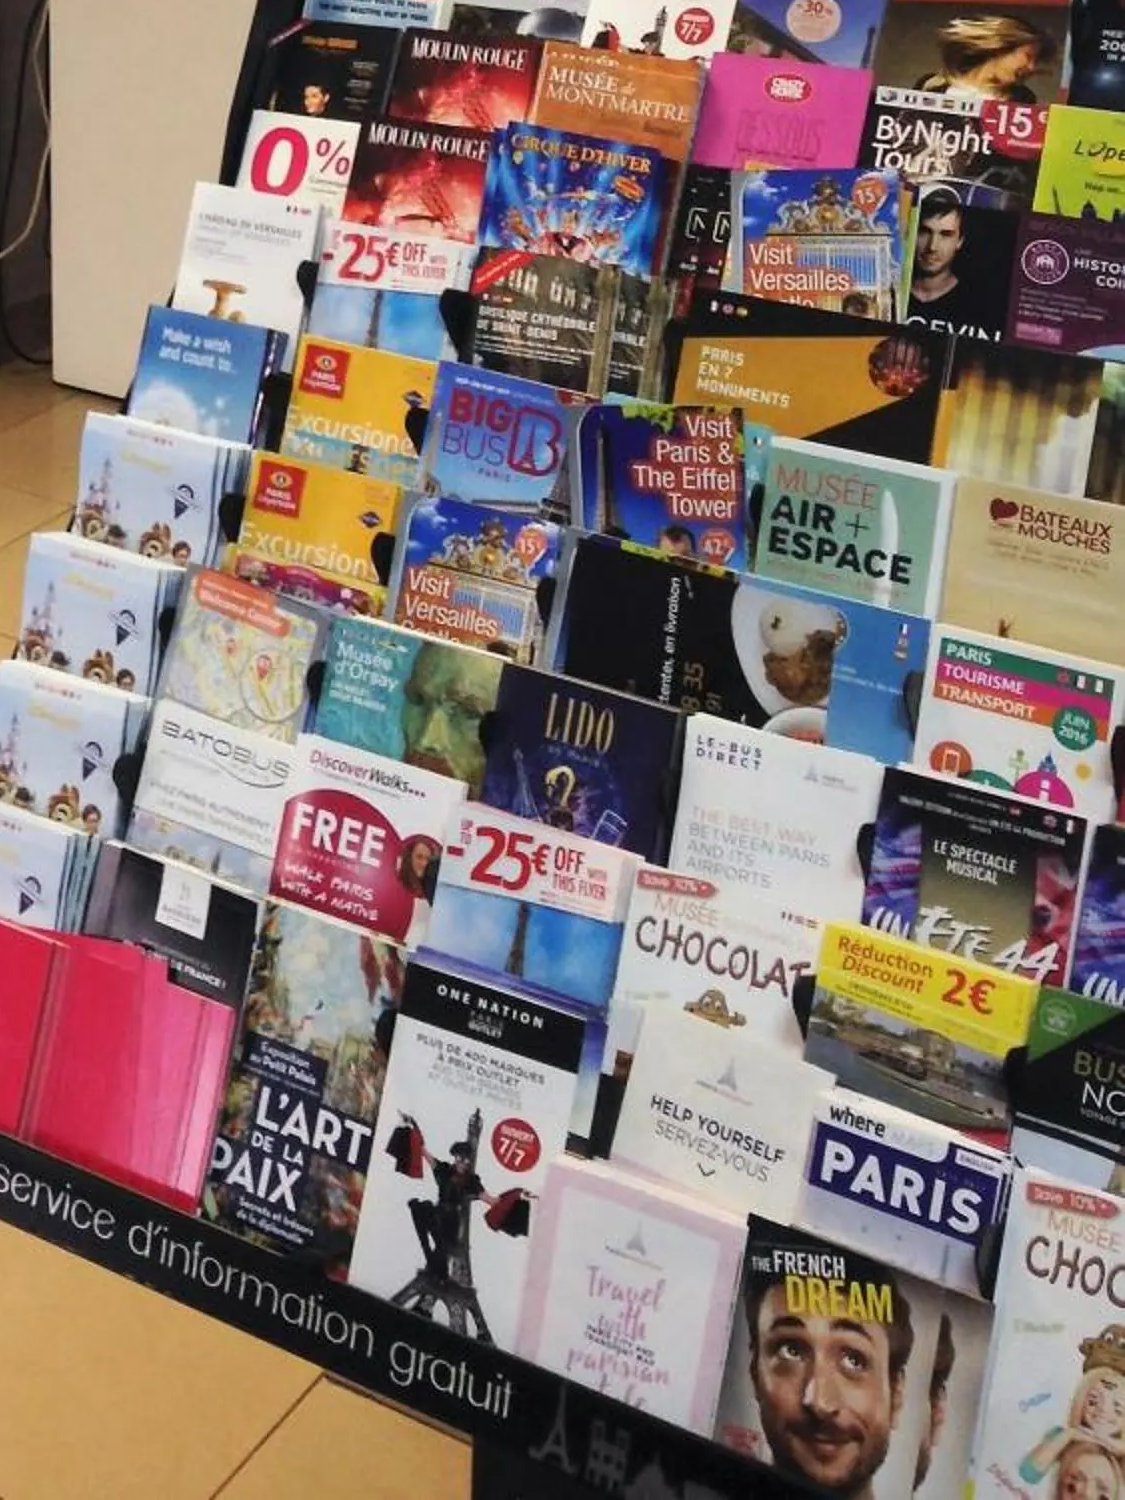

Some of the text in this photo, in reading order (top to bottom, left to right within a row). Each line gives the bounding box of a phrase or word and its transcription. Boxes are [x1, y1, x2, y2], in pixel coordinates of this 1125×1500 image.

[412, 36, 528, 71] MOULIN ROUGE
[549, 66, 619, 93] MUSÉE
[546, 83, 691, 122] MONTMARTRE
[368, 123, 491, 162] MOULIN ROUGE
[511, 133, 578, 160] CIRQUE
[876, 115, 994, 158] By Night
[871, 143, 949, 176] Tours
[403, 242, 427, 264] OFF
[749, 243, 794, 266] Visit
[750, 268, 852, 294] Versailles
[698, 362, 720, 377] EN
[701, 344, 746, 366] PARIS
[448, 386, 513, 434] BIG
[696, 376, 792, 409] MONUMENTS
[684, 415, 734, 439] Visit
[442, 424, 508, 467] BUS
[656, 440, 735, 465] Paris &
[633, 464, 737, 493] The Eiffel
[775, 463, 880, 512] MUSÉE
[668, 492, 736, 519] Tower
[770, 494, 838, 534] AIR
[1018, 503, 1113, 541] BATEAUX
[768, 525, 914, 587] ESPACE
[1017, 524, 1112, 557] MOUCHES
[408, 568, 452, 600] Visit
[402, 593, 500, 638] Versailles
[336, 640, 393, 671] Musée
[945, 642, 993, 666] PARIS
[942, 662, 1026, 696] TOURISME
[939, 683, 1037, 719] TRANSPORT
[544, 693, 615, 753] LIDO
[161, 718, 291, 781] BATOBUS
[695, 747, 762, 772] DIRECT
[290, 801, 387, 870] FREE
[691, 805, 819, 847] THE BEST WAY
[554, 844, 587, 874] OFF
[686, 841, 757, 867] AND ITS
[688, 822, 831, 869] BETWEEN PARIS
[933, 838, 1020, 875] LE SPECTACLE
[552, 873, 577, 894] THIS
[685, 856, 774, 890] AIRPORTS
[946, 858, 999, 887] MUSICAL
[654, 893, 719, 928] MUSÉE
[635, 915, 812, 998] CHOCOLAT
[837, 934, 934, 979] Réduction
[841, 954, 925, 996] Discount
[939, 967, 997, 1017] 2€
[436, 983, 546, 1030] ONE NATION
[256, 1085, 373, 1166] L'ART
[649, 1095, 787, 1165] HELP YOURSELF
[829, 1104, 888, 1139] where
[251, 1131, 305, 1167] DE LA
[499, 1136, 526, 1167] 7/7
[653, 1118, 771, 1184] SERVEZ-VOUS
[210, 1137, 305, 1213] PAIX
[819, 1138, 983, 1235] PARIS
[749, 1250, 847, 1281] THE FRENCH
[586, 1264, 668, 1313] Travel
[786, 1274, 895, 1326] DREAM
[127, 1220, 376, 1359] d'information
[389, 1340, 514, 1421] gratuit
